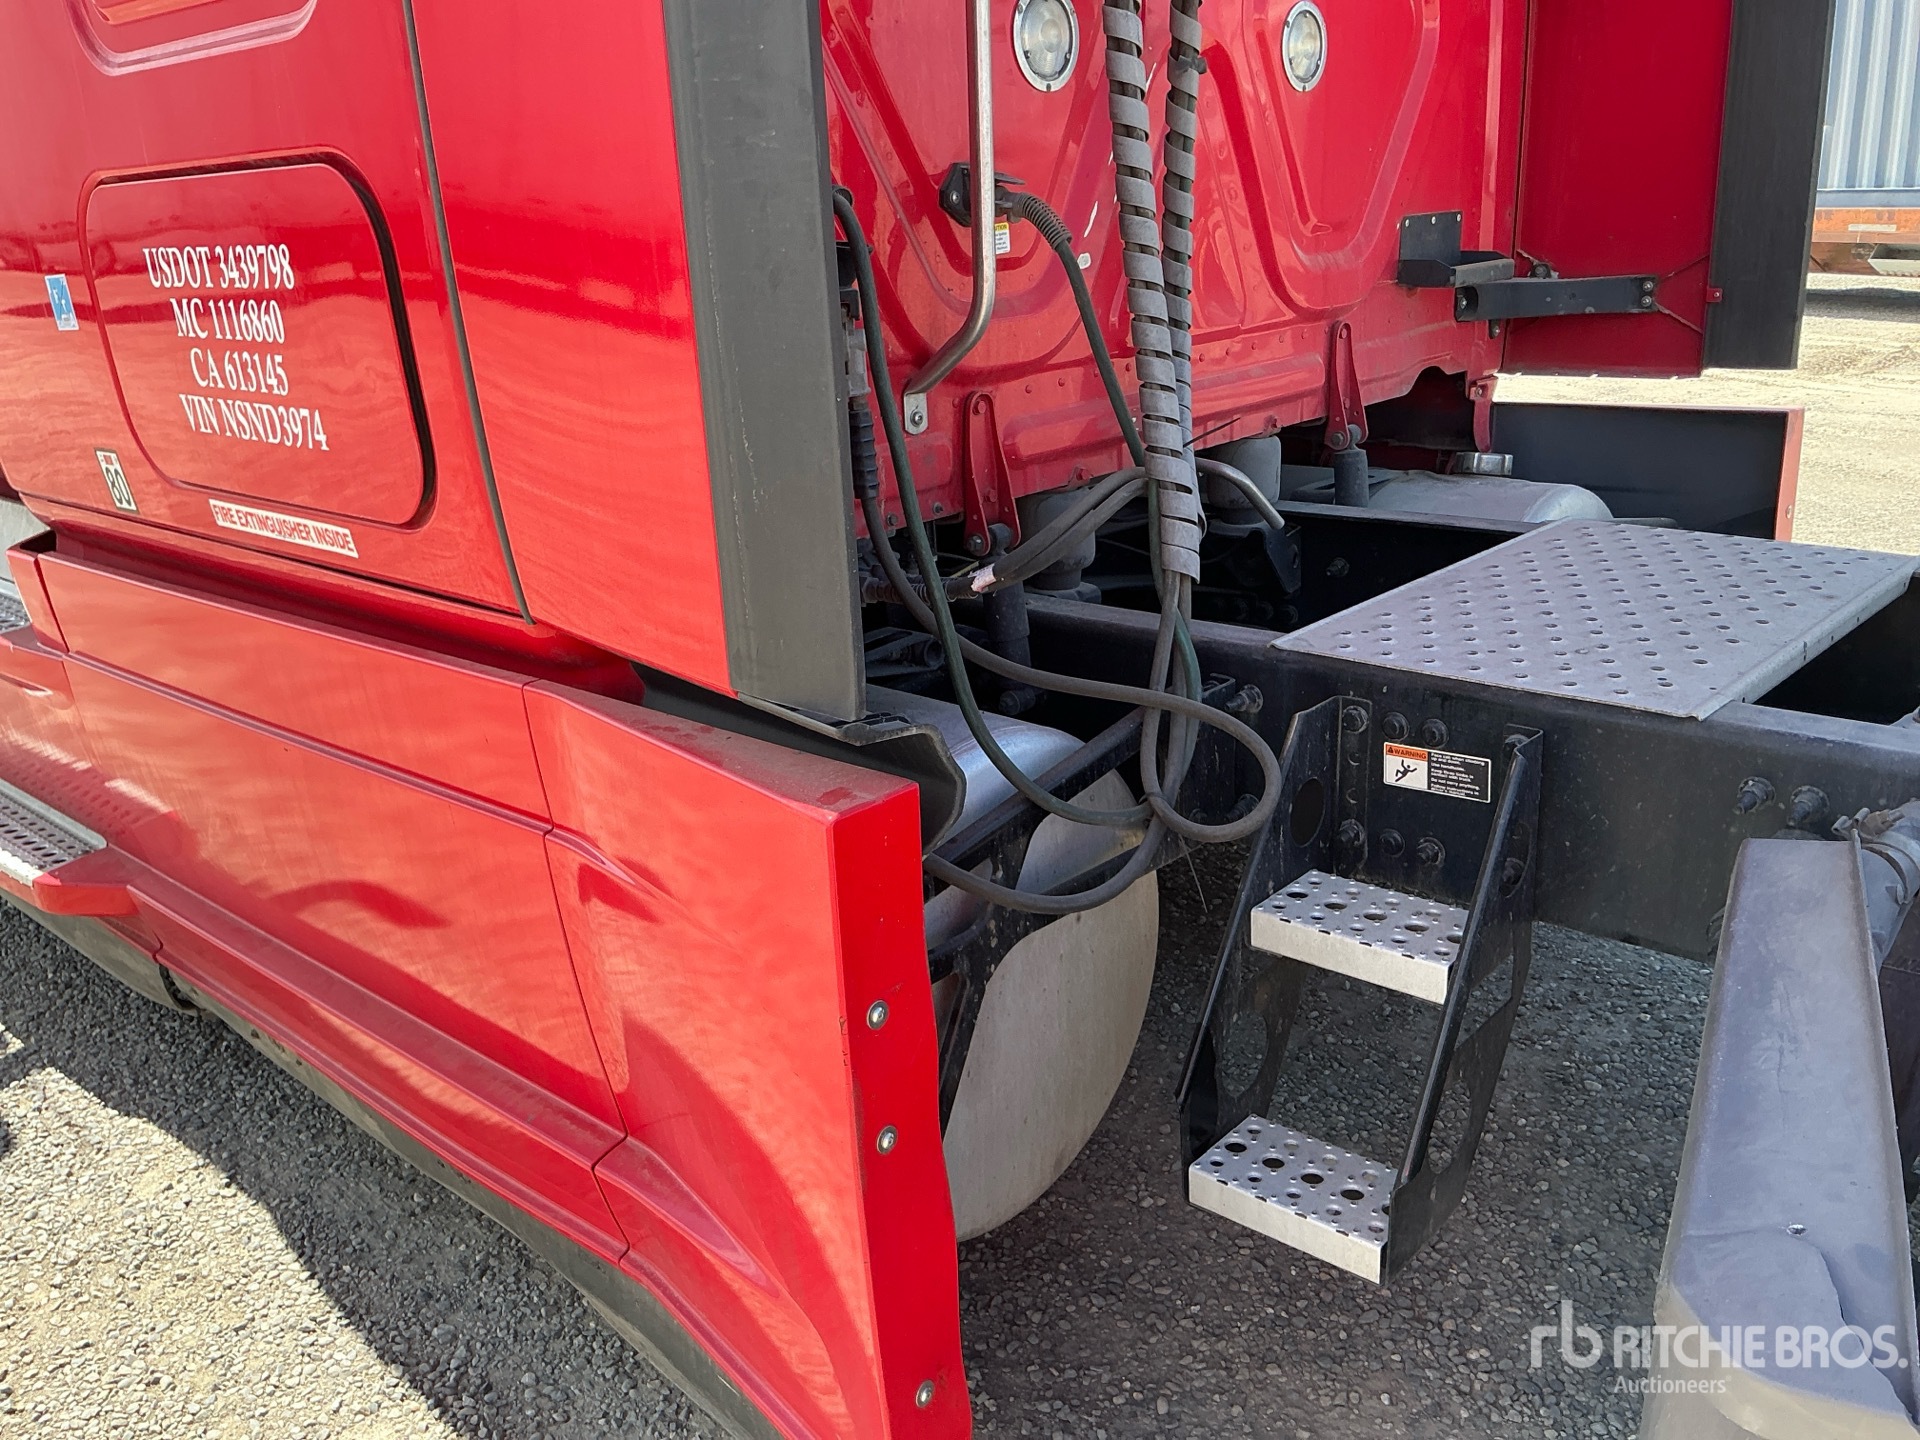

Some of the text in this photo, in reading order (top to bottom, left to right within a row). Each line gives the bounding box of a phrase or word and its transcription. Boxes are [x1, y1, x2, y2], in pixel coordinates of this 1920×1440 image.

[142, 243, 295, 290] USDOT 3439798
[169, 297, 285, 344] MC 1116860
[190, 347, 289, 396] CA 613145
[178, 393, 330, 451] VIN NSND3974
[105, 466, 132, 507] 80
[212, 504, 356, 553] FIRE EXTINGUISHER INSIDE
[1394, 748, 1427, 760] WARNING
